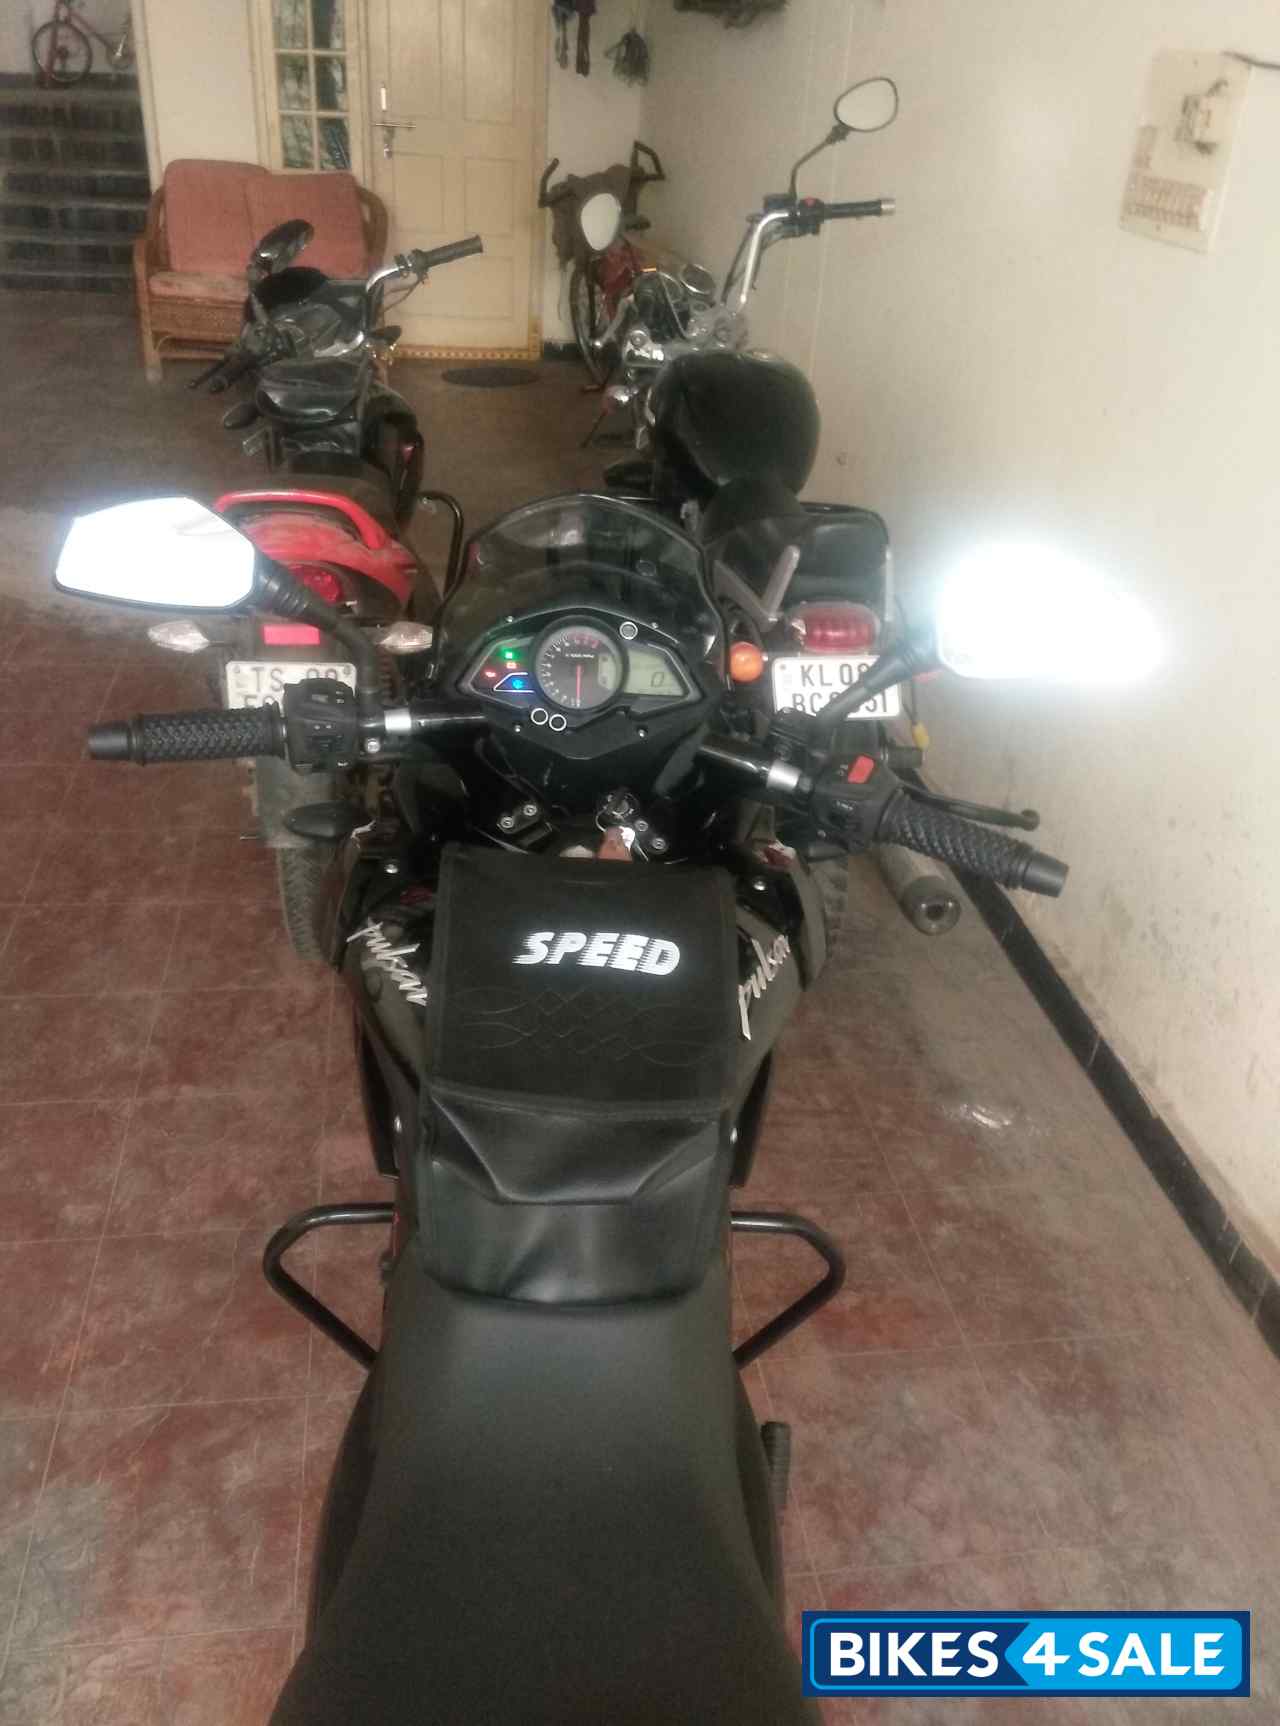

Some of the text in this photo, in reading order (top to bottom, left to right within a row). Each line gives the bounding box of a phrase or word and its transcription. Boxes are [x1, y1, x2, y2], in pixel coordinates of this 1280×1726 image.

[251, 666, 283, 692] TS
[800, 664, 832, 686] KL
[512, 931, 681, 976] SPEED
